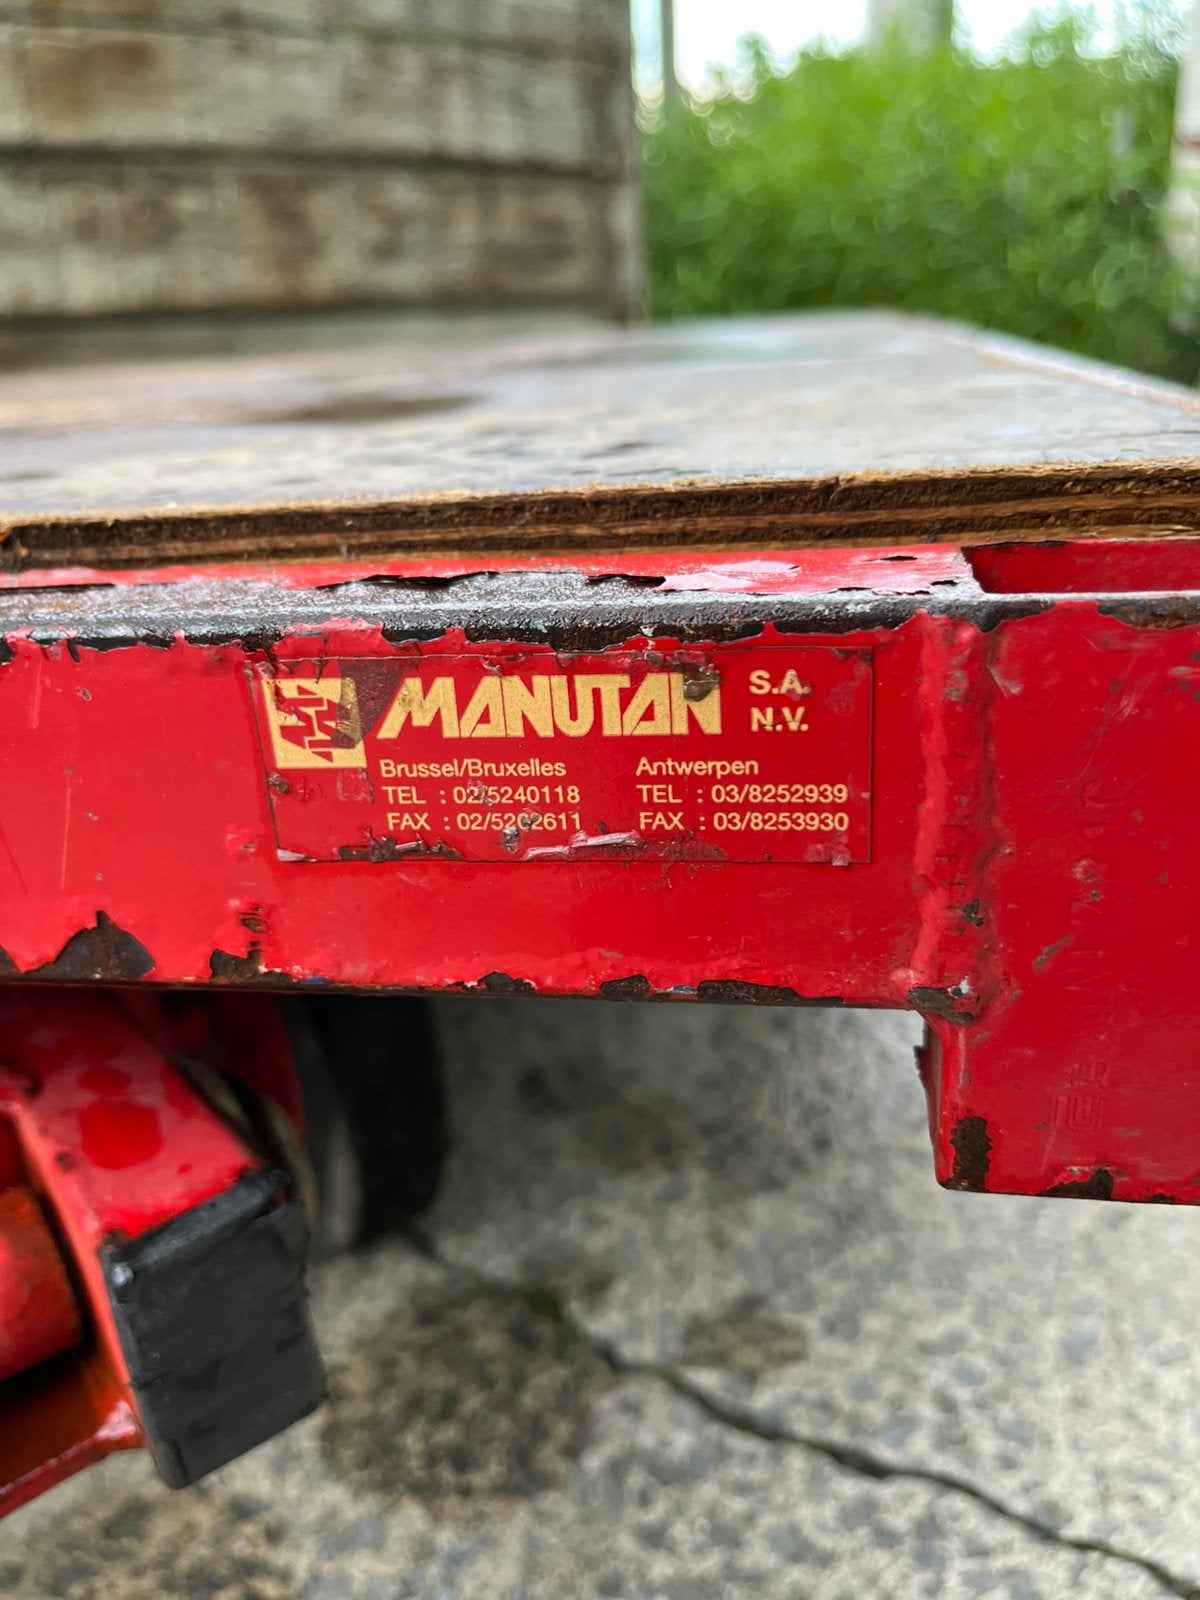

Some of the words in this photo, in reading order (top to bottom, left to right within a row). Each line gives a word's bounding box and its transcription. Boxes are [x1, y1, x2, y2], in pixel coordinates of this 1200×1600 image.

[749, 669, 812, 695] S.A.
[376, 673, 722, 739] MANUTAN
[751, 706, 809, 732] N.V.
[380, 758, 567, 778] Brussel/Bruxelles
[636, 757, 759, 779] Antwerpen
[381, 786, 427, 804] TEL
[636, 784, 682, 804] TEL
[711, 784, 848, 804] 03/8252939
[387, 812, 431, 831] FAX
[639, 811, 685, 831] FAX
[713, 811, 849, 831] 03/8253930
